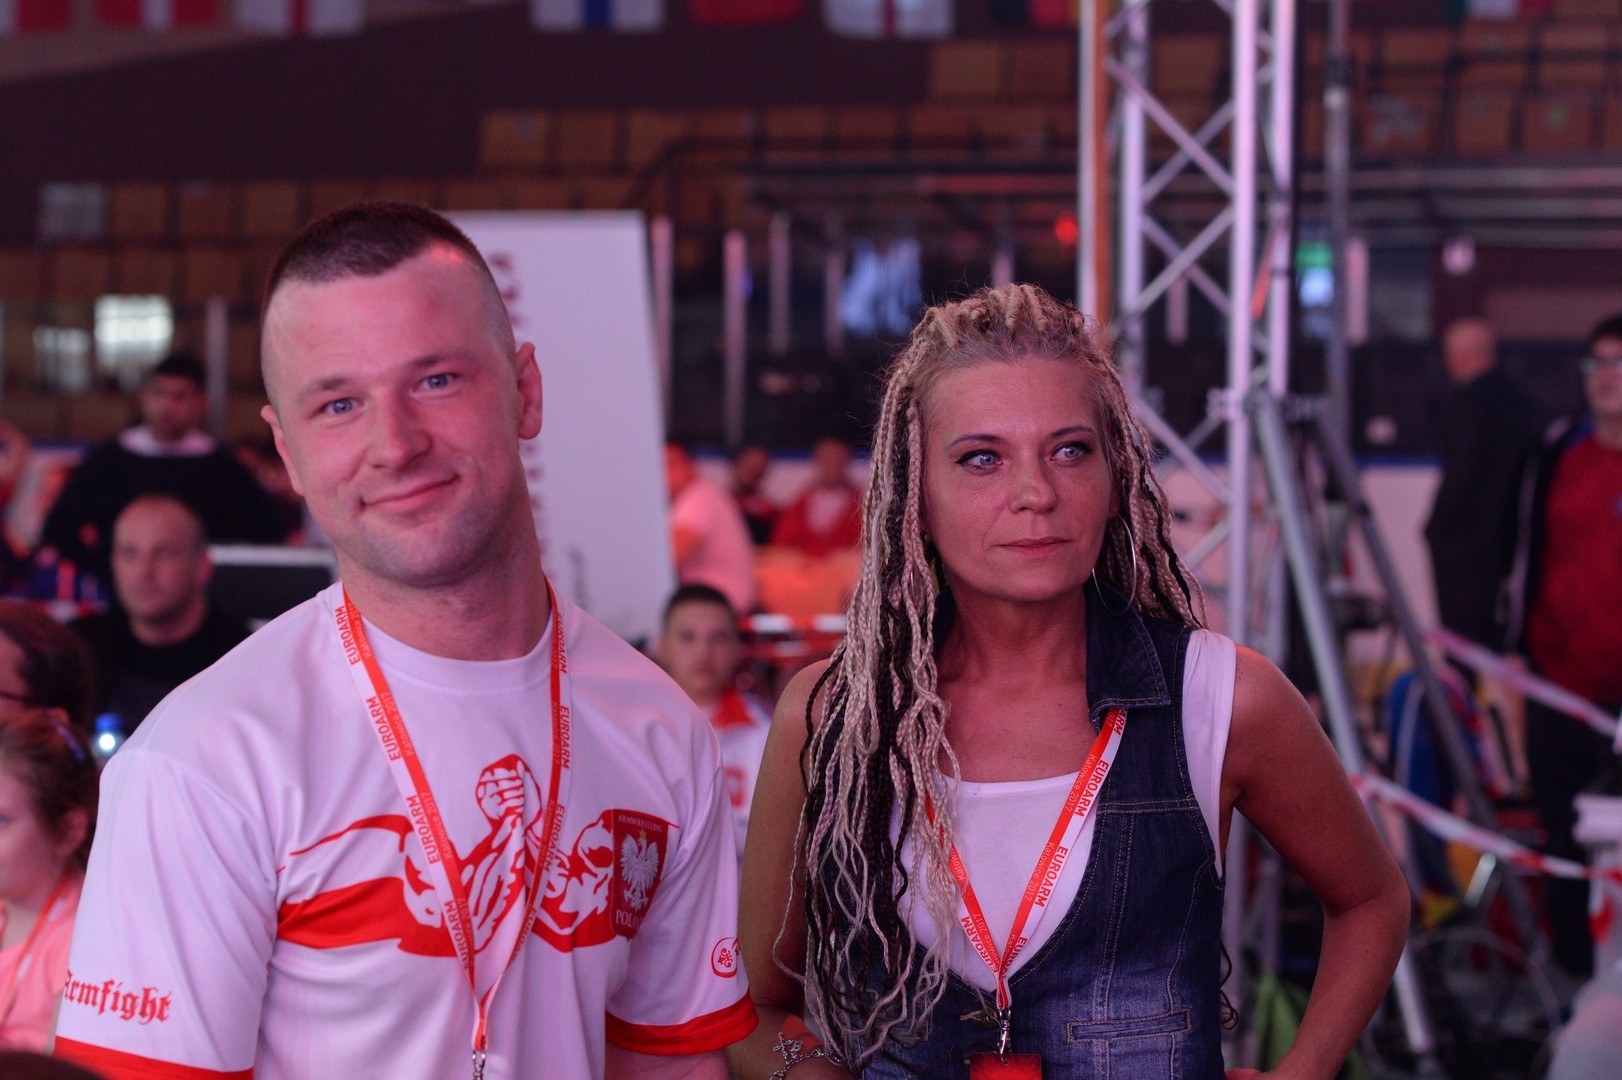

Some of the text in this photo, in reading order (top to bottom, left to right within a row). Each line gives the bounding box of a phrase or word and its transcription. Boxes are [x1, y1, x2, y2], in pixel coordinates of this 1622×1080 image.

[335, 605, 361, 666] EUROARM
[366, 696, 401, 761] EUROARM
[380, 692, 397, 713] 2017
[560, 705, 571, 770] EUROARM
[1065, 754, 1097, 812] Katowice 2017
[1074, 759, 1109, 817] EUROARM
[406, 795, 441, 864] EUROARM
[543, 804, 565, 871] EUROARM
[618, 814, 662, 832] ARMWRESTLING
[1024, 842, 1056, 902] Katowice 2017
[1035, 845, 1069, 908] EUROARM
[960, 916, 998, 974] EUROARM
[972, 914, 986, 935] 2017
